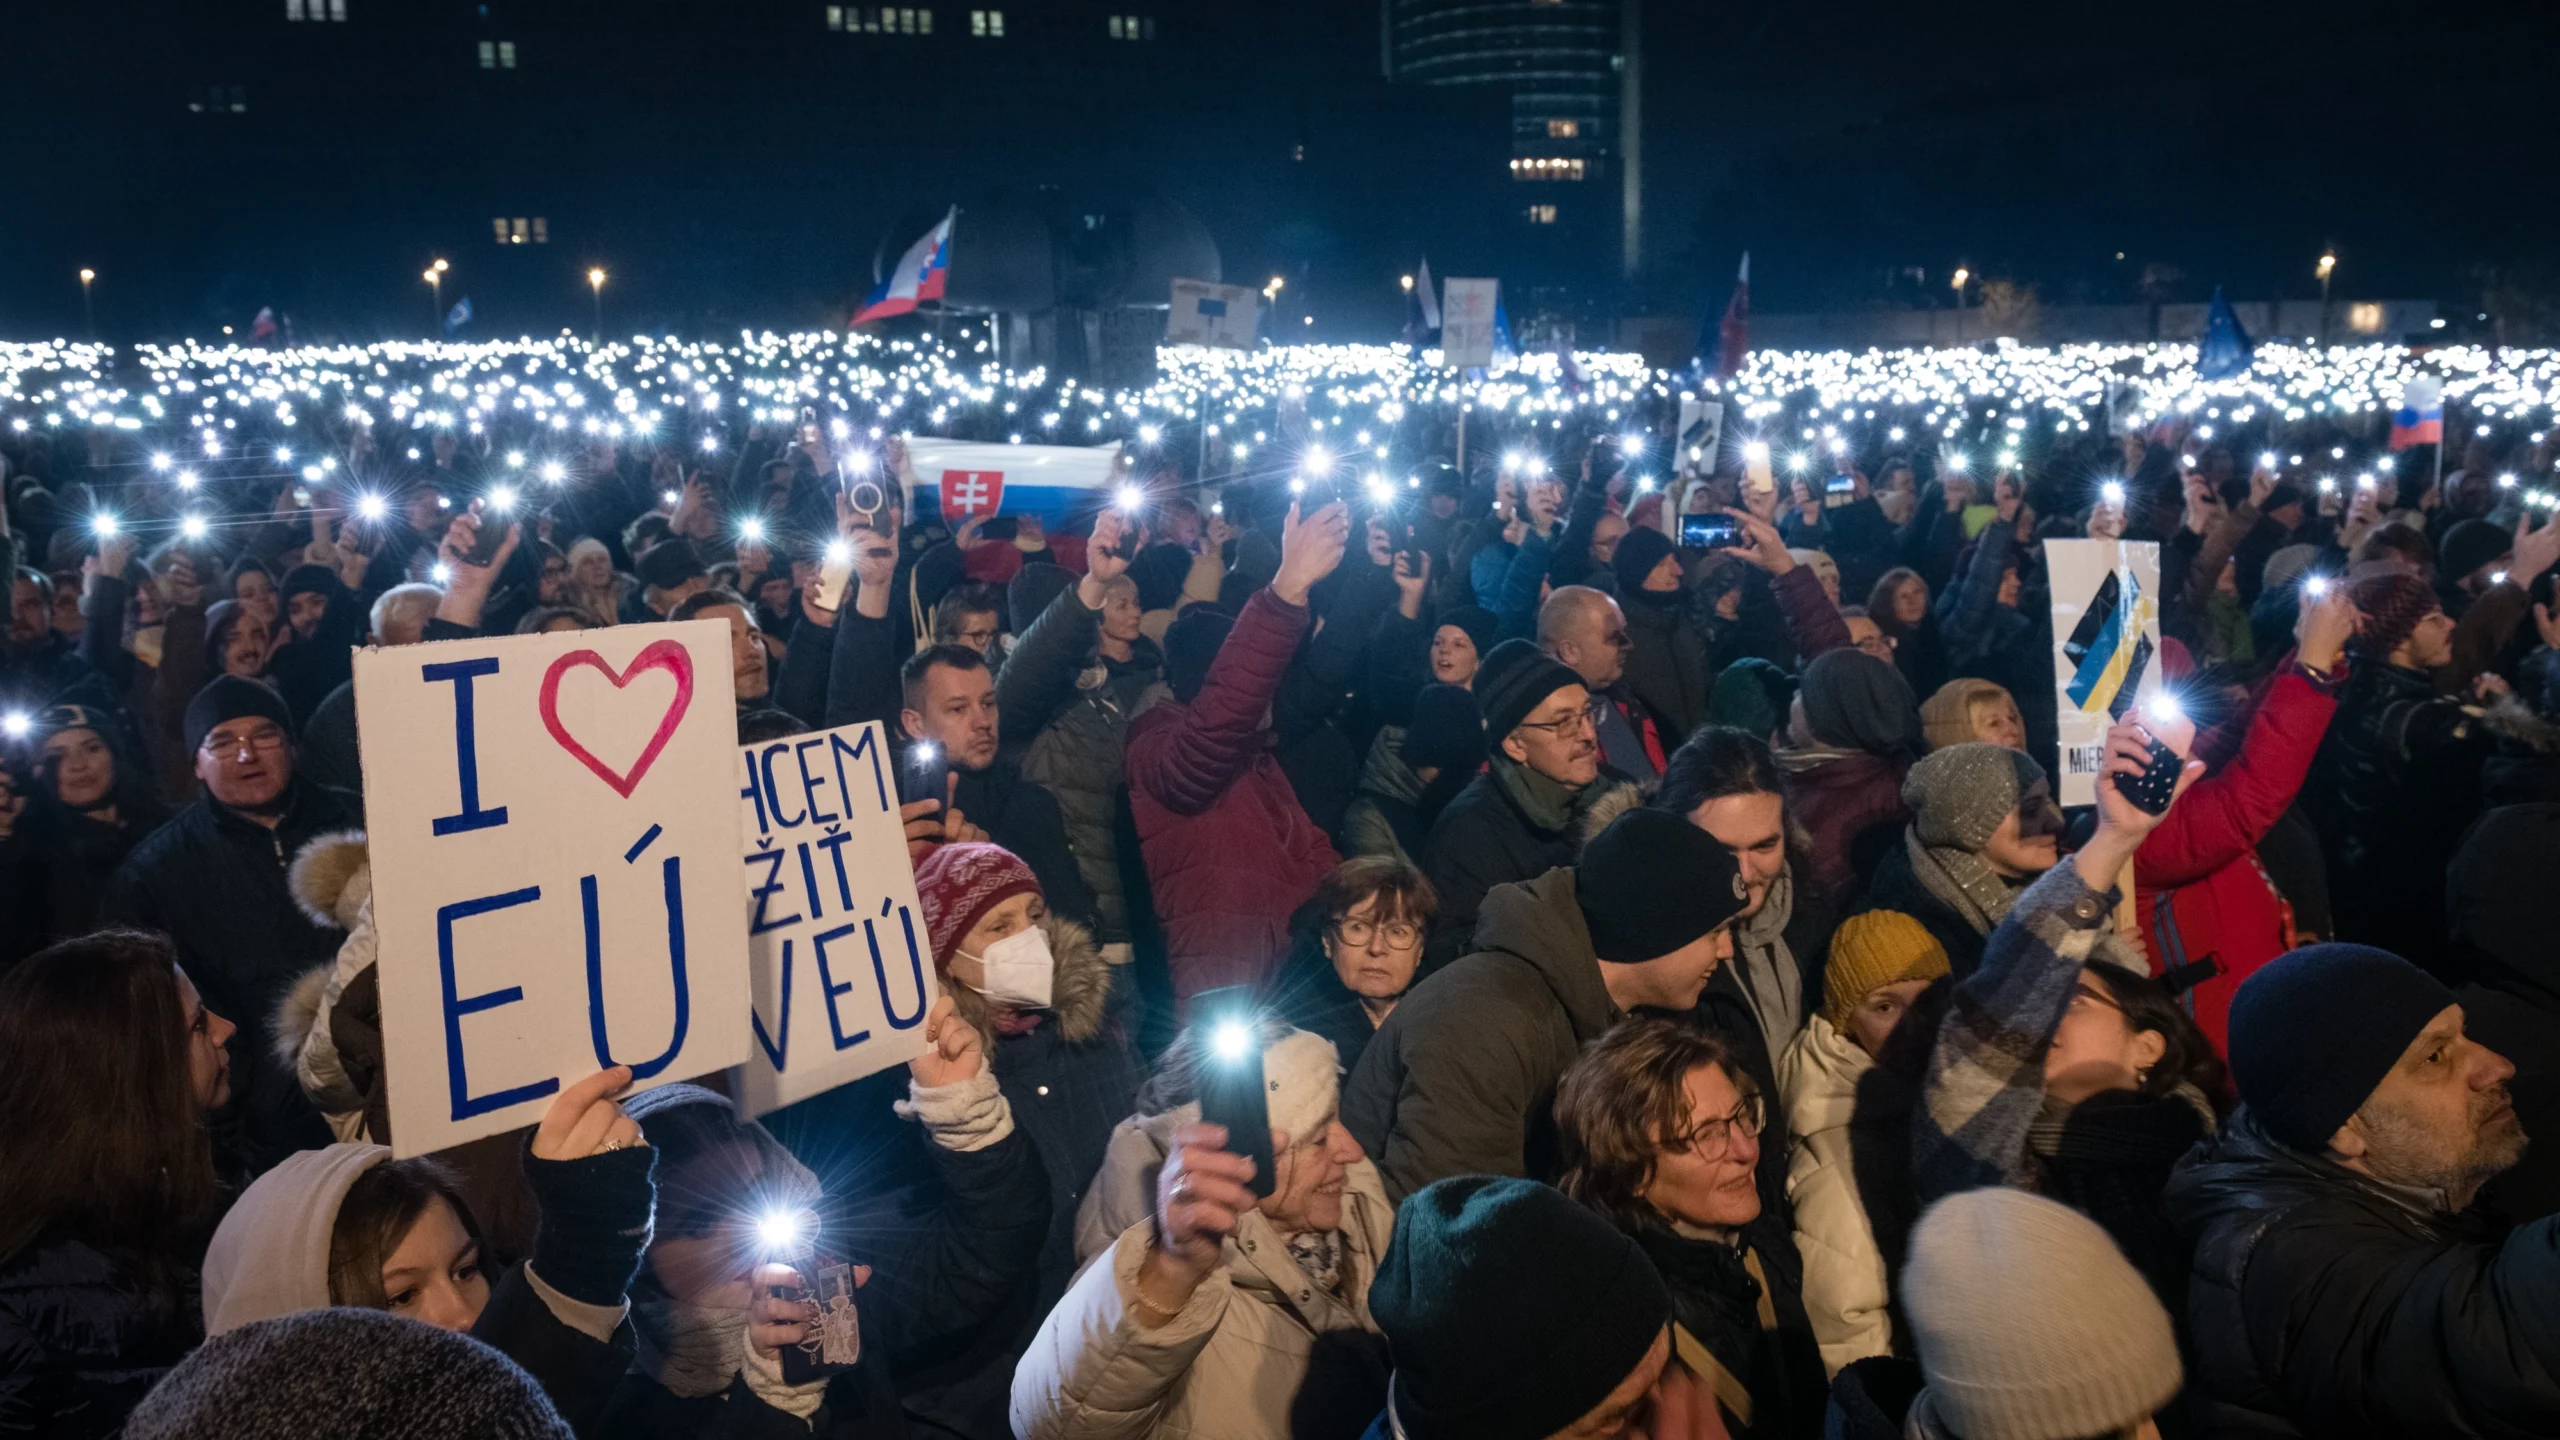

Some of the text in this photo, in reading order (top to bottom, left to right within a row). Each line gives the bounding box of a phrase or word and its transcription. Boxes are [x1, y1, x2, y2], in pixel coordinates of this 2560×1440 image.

[421, 656, 508, 836] I
[744, 823, 854, 936] ŽIŤ
[436, 823, 690, 1122] EÚ
